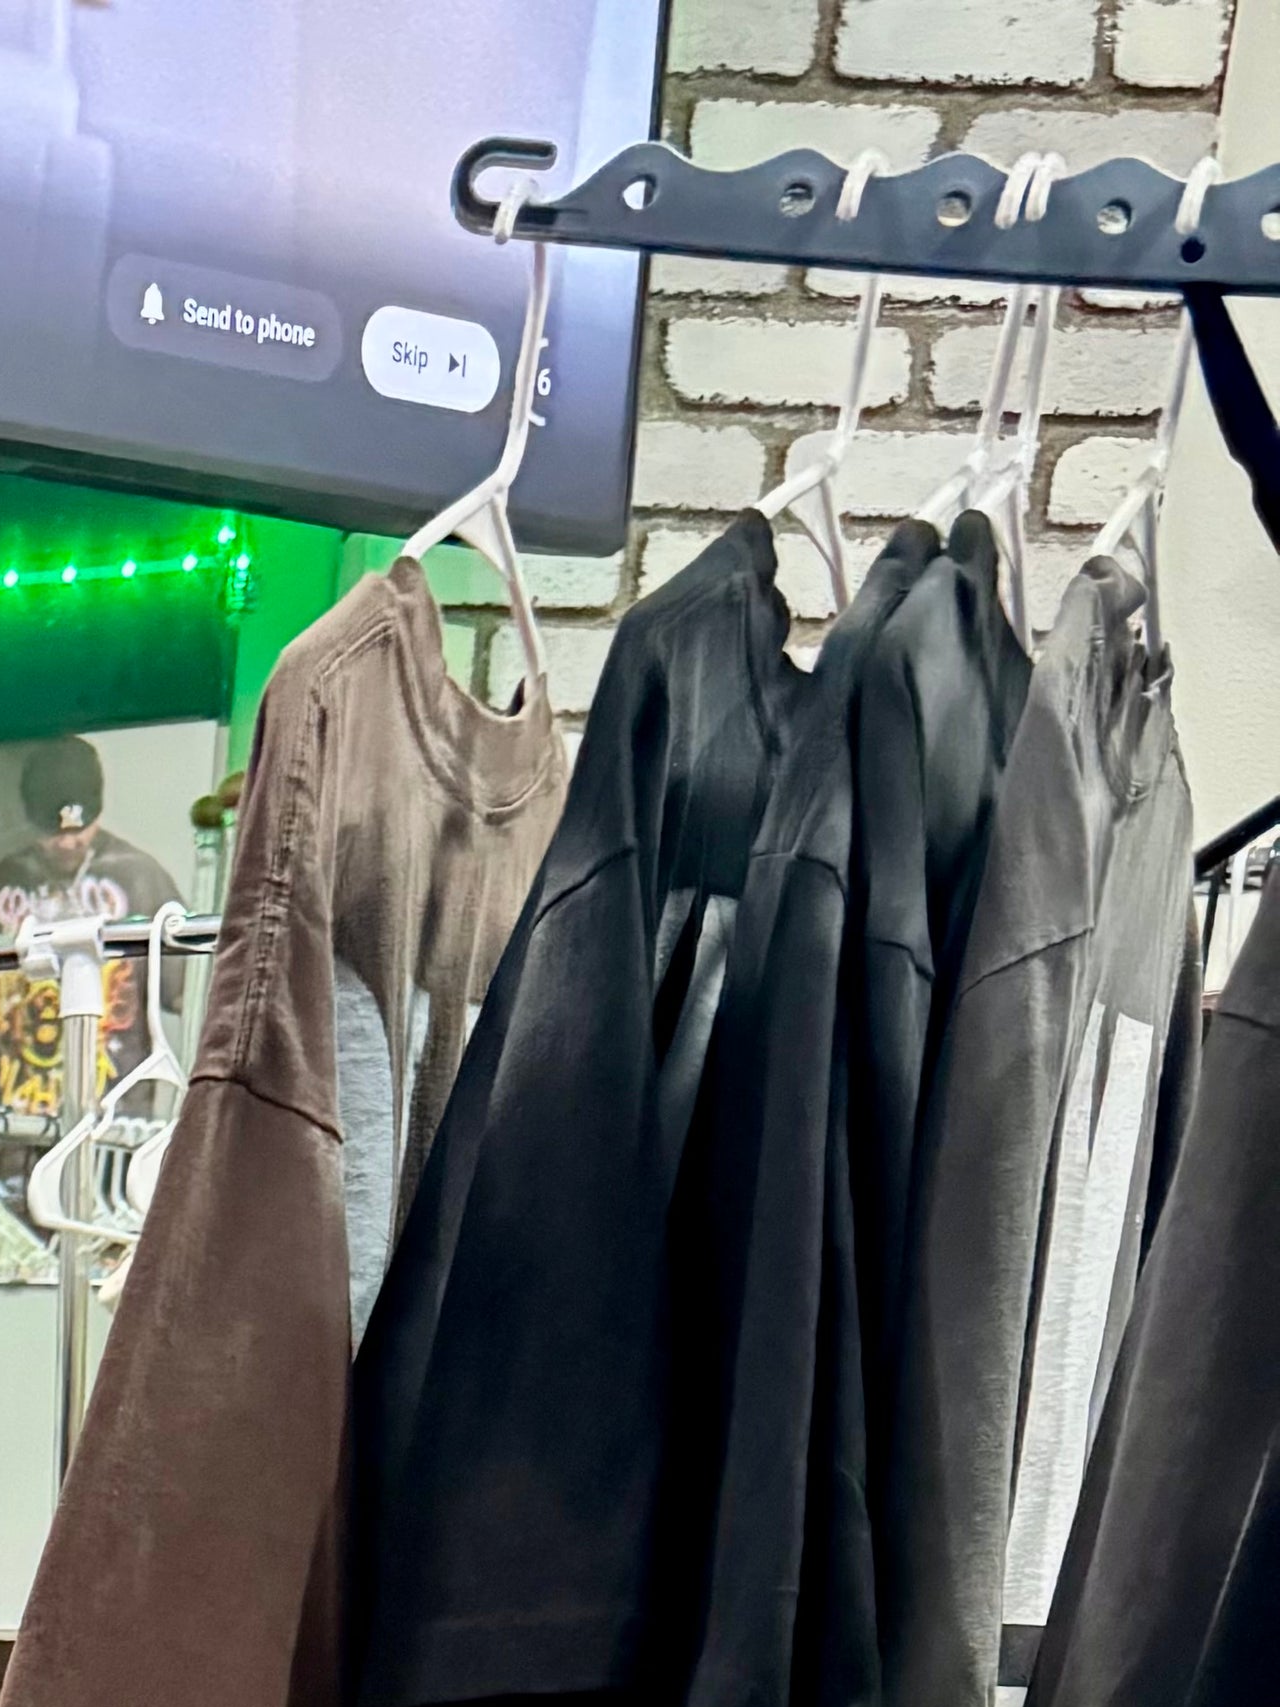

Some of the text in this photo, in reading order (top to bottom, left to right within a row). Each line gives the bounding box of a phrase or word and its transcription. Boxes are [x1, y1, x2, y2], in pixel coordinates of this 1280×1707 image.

[183, 297, 316, 347] Send to phone
[391, 340, 429, 375] Skip
